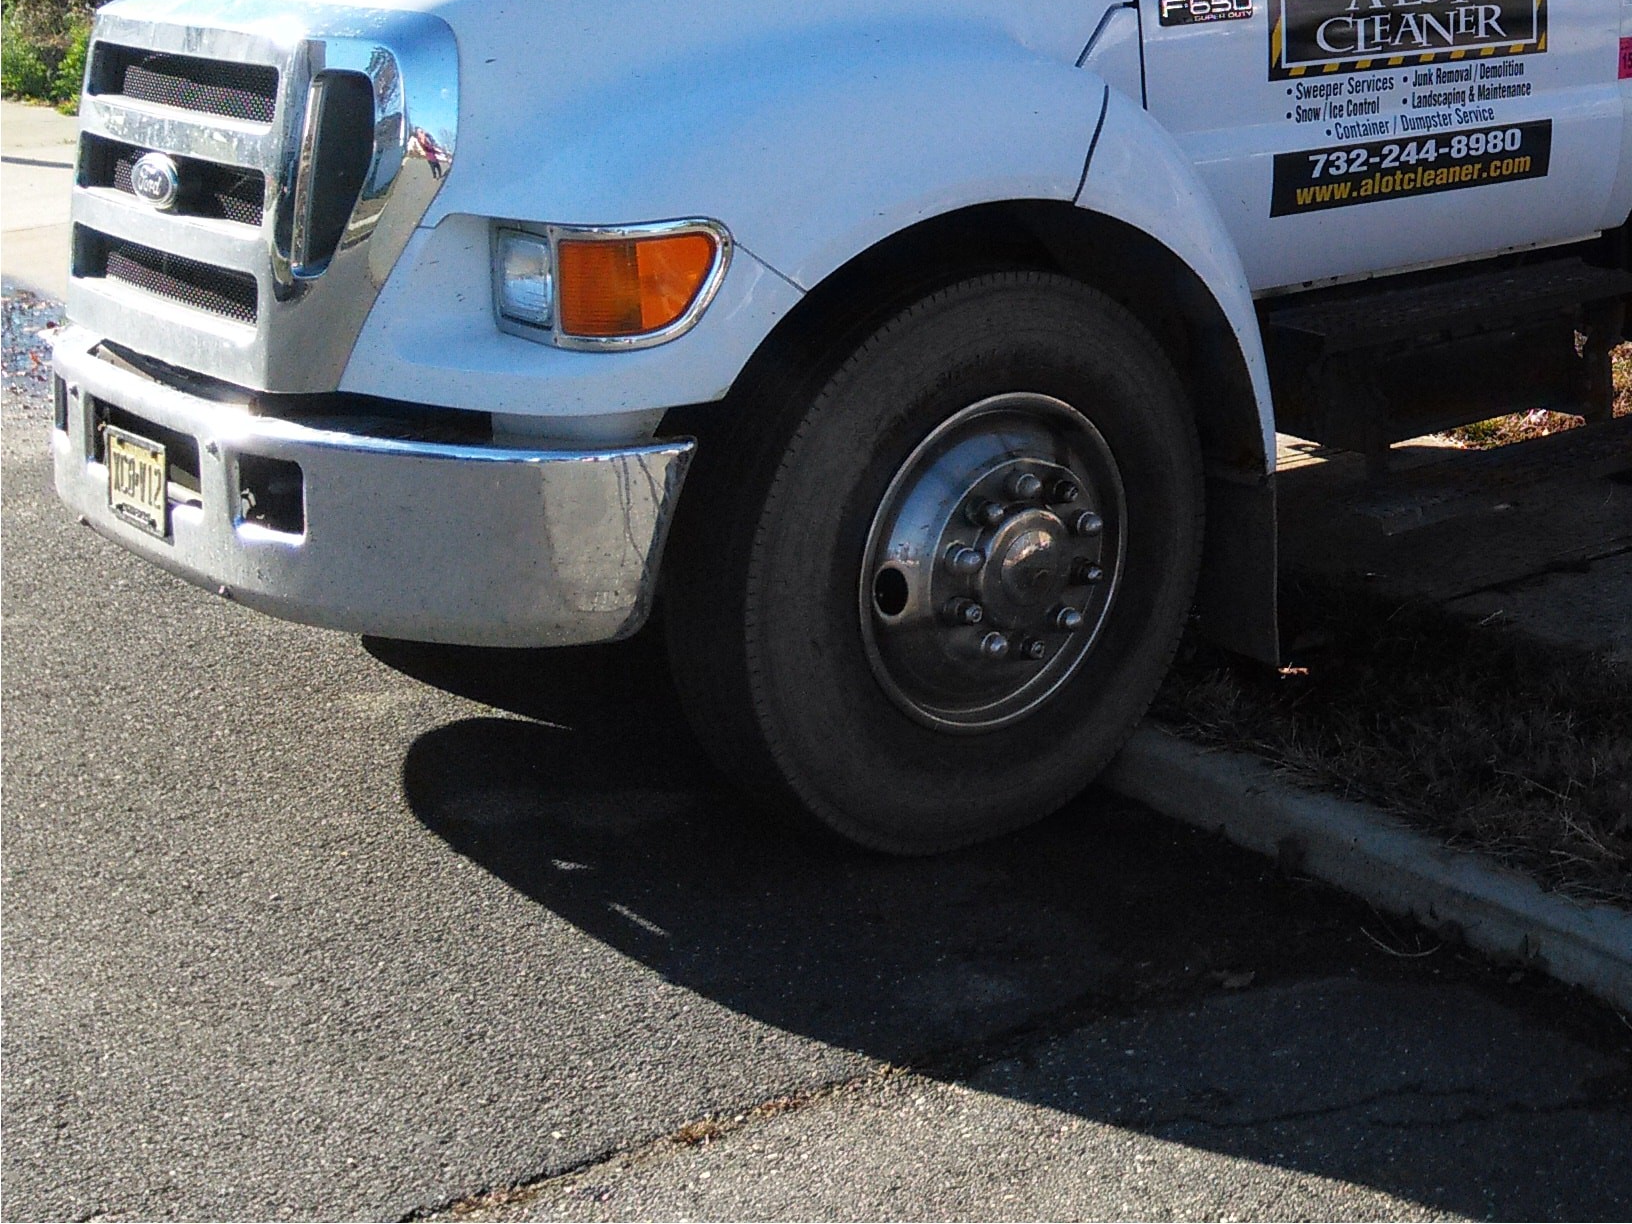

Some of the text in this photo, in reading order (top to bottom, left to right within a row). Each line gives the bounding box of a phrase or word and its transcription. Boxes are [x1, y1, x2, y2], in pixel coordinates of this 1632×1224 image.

[1194, 10, 1252, 22] SUPER DUTY
[1316, 4, 1507, 53] CLEANER
[1295, 74, 1394, 101] Sweeper Services
[1412, 68, 1433, 87] Junk
[1436, 64, 1472, 84] Removal
[1480, 60, 1524, 80] Demolition
[1412, 85, 1466, 109] Landscaping
[1477, 81, 1531, 101] Maintenance
[1295, 104, 1321, 123] Snow
[1329, 101, 1343, 120] Ice
[1346, 96, 1380, 118] Control
[1334, 119, 1390, 140] Container
[1400, 110, 1452, 132] Dumpster
[1455, 106, 1494, 125] Service
[1309, 128, 1522, 179] 732-244-8980
[1296, 155, 1531, 206] www.alotcleaner.com
